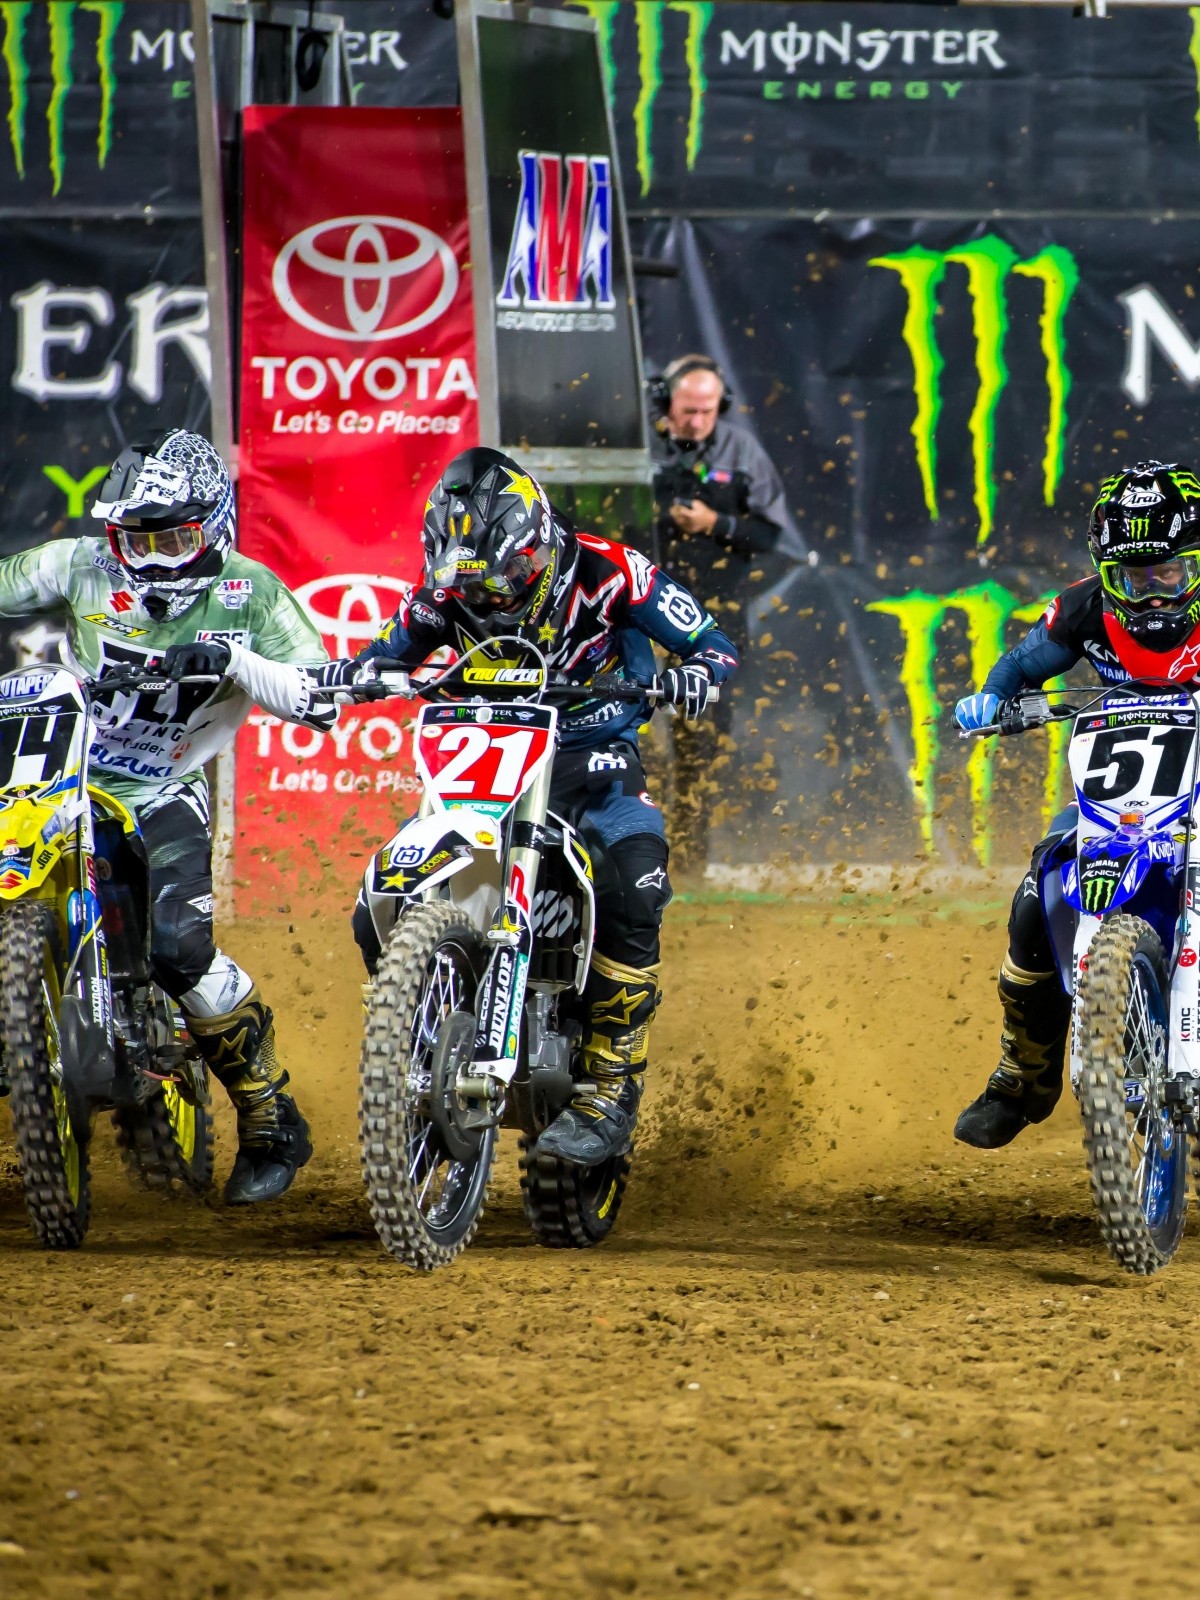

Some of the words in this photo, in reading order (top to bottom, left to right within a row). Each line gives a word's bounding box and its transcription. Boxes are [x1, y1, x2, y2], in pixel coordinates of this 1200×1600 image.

[720, 21, 1008, 74] MONSTER
[763, 81, 964, 100] ENERGY
[252, 356, 478, 400] TOYOTA
[273, 410, 329, 434] Let's
[338, 410, 380, 434] Go
[386, 410, 461, 434] Places
[1128, 492, 1160, 506] Arai
[1107, 541, 1170, 555] MONSTER
[1118, 710, 1170, 722] MONSTER
[247, 716, 418, 761] TOYO
[89, 742, 174, 778] SUZUKI
[432, 726, 535, 797] 21
[1083, 727, 1197, 801] 51
[269, 767, 329, 793] Let's
[461, 803, 504, 813] MOTOREX
[1081, 868, 1121, 880] KNICH
[1086, 860, 1119, 869] YAMAHA
[489, 951, 513, 1050] DUNLOP
[509, 956, 529, 1035] MOTOREX
[1125, 1084, 1140, 1097] 51
